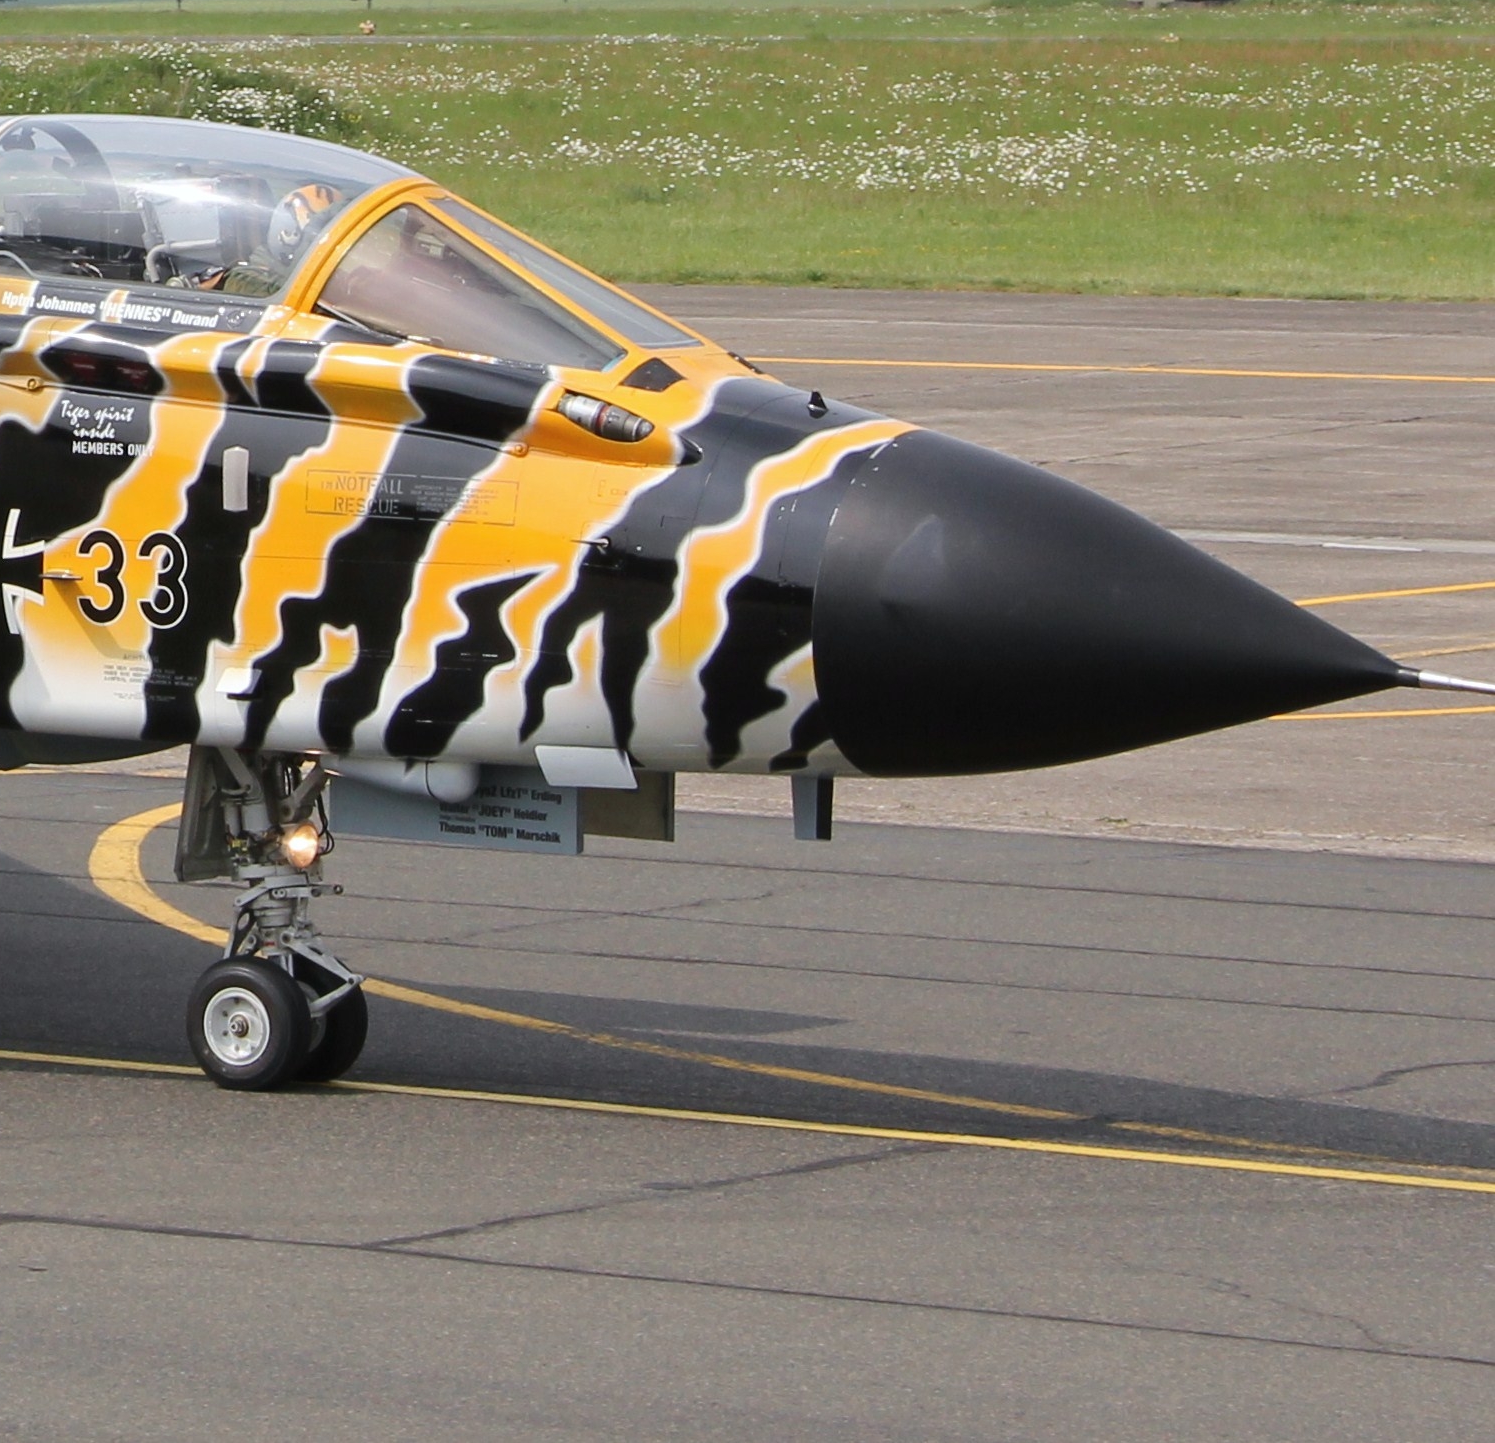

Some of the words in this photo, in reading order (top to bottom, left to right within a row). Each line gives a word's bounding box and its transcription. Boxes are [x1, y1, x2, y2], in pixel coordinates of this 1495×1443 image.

[36, 294, 95, 315] Johannes
[99, 299, 171, 323] "HENNES"
[171, 310, 218, 328] Durand
[60, 399, 90, 425] Tiger
[93, 406, 135, 429] spirit
[73, 422, 115, 439] inside
[72, 440, 124, 456] MEMBERS
[336, 475, 403, 495] NOTFALL
[334, 496, 400, 515] RESCUE
[76, 529, 188, 629] 33
[439, 821, 476, 835] Thomas
[478, 825, 514, 839] "TOM"
[516, 828, 561, 844] Marschik
